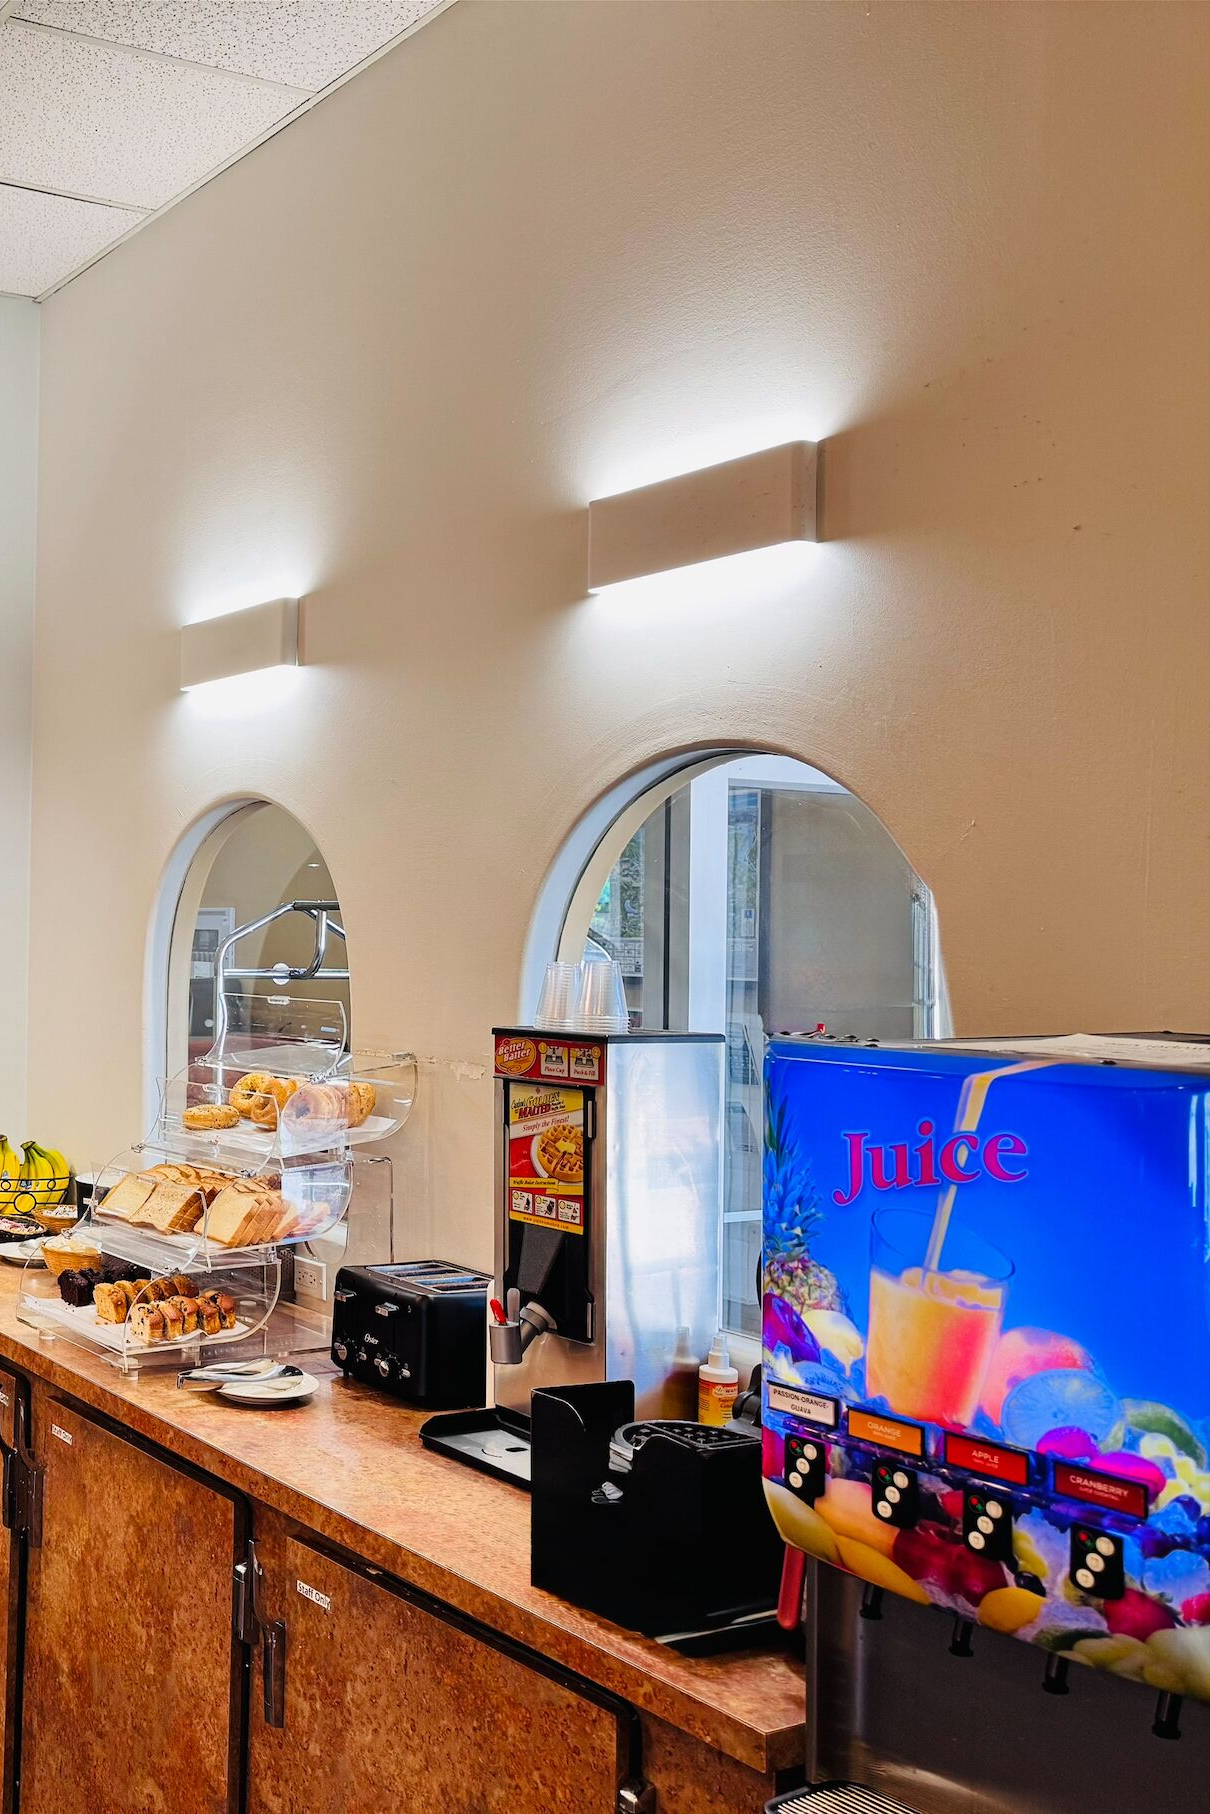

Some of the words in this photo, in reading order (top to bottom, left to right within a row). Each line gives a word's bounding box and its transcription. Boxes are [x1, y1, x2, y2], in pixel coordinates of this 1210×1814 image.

[498, 1041, 526, 1055] Better
[503, 1048, 531, 1063] Batter
[518, 1103, 551, 1119] MALTED
[523, 1122, 540, 1132] Simply
[831, 1119, 1028, 1206] Juice
[790, 1403, 812, 1415] GUAVA
[867, 1421, 902, 1438] ORANGE
[971, 1449, 1000, 1464] APPLE
[1069, 1474, 1129, 1498] CRANBERRY
[298, 1582, 314, 1599] Staff
[314, 1592, 331, 1611] Only
